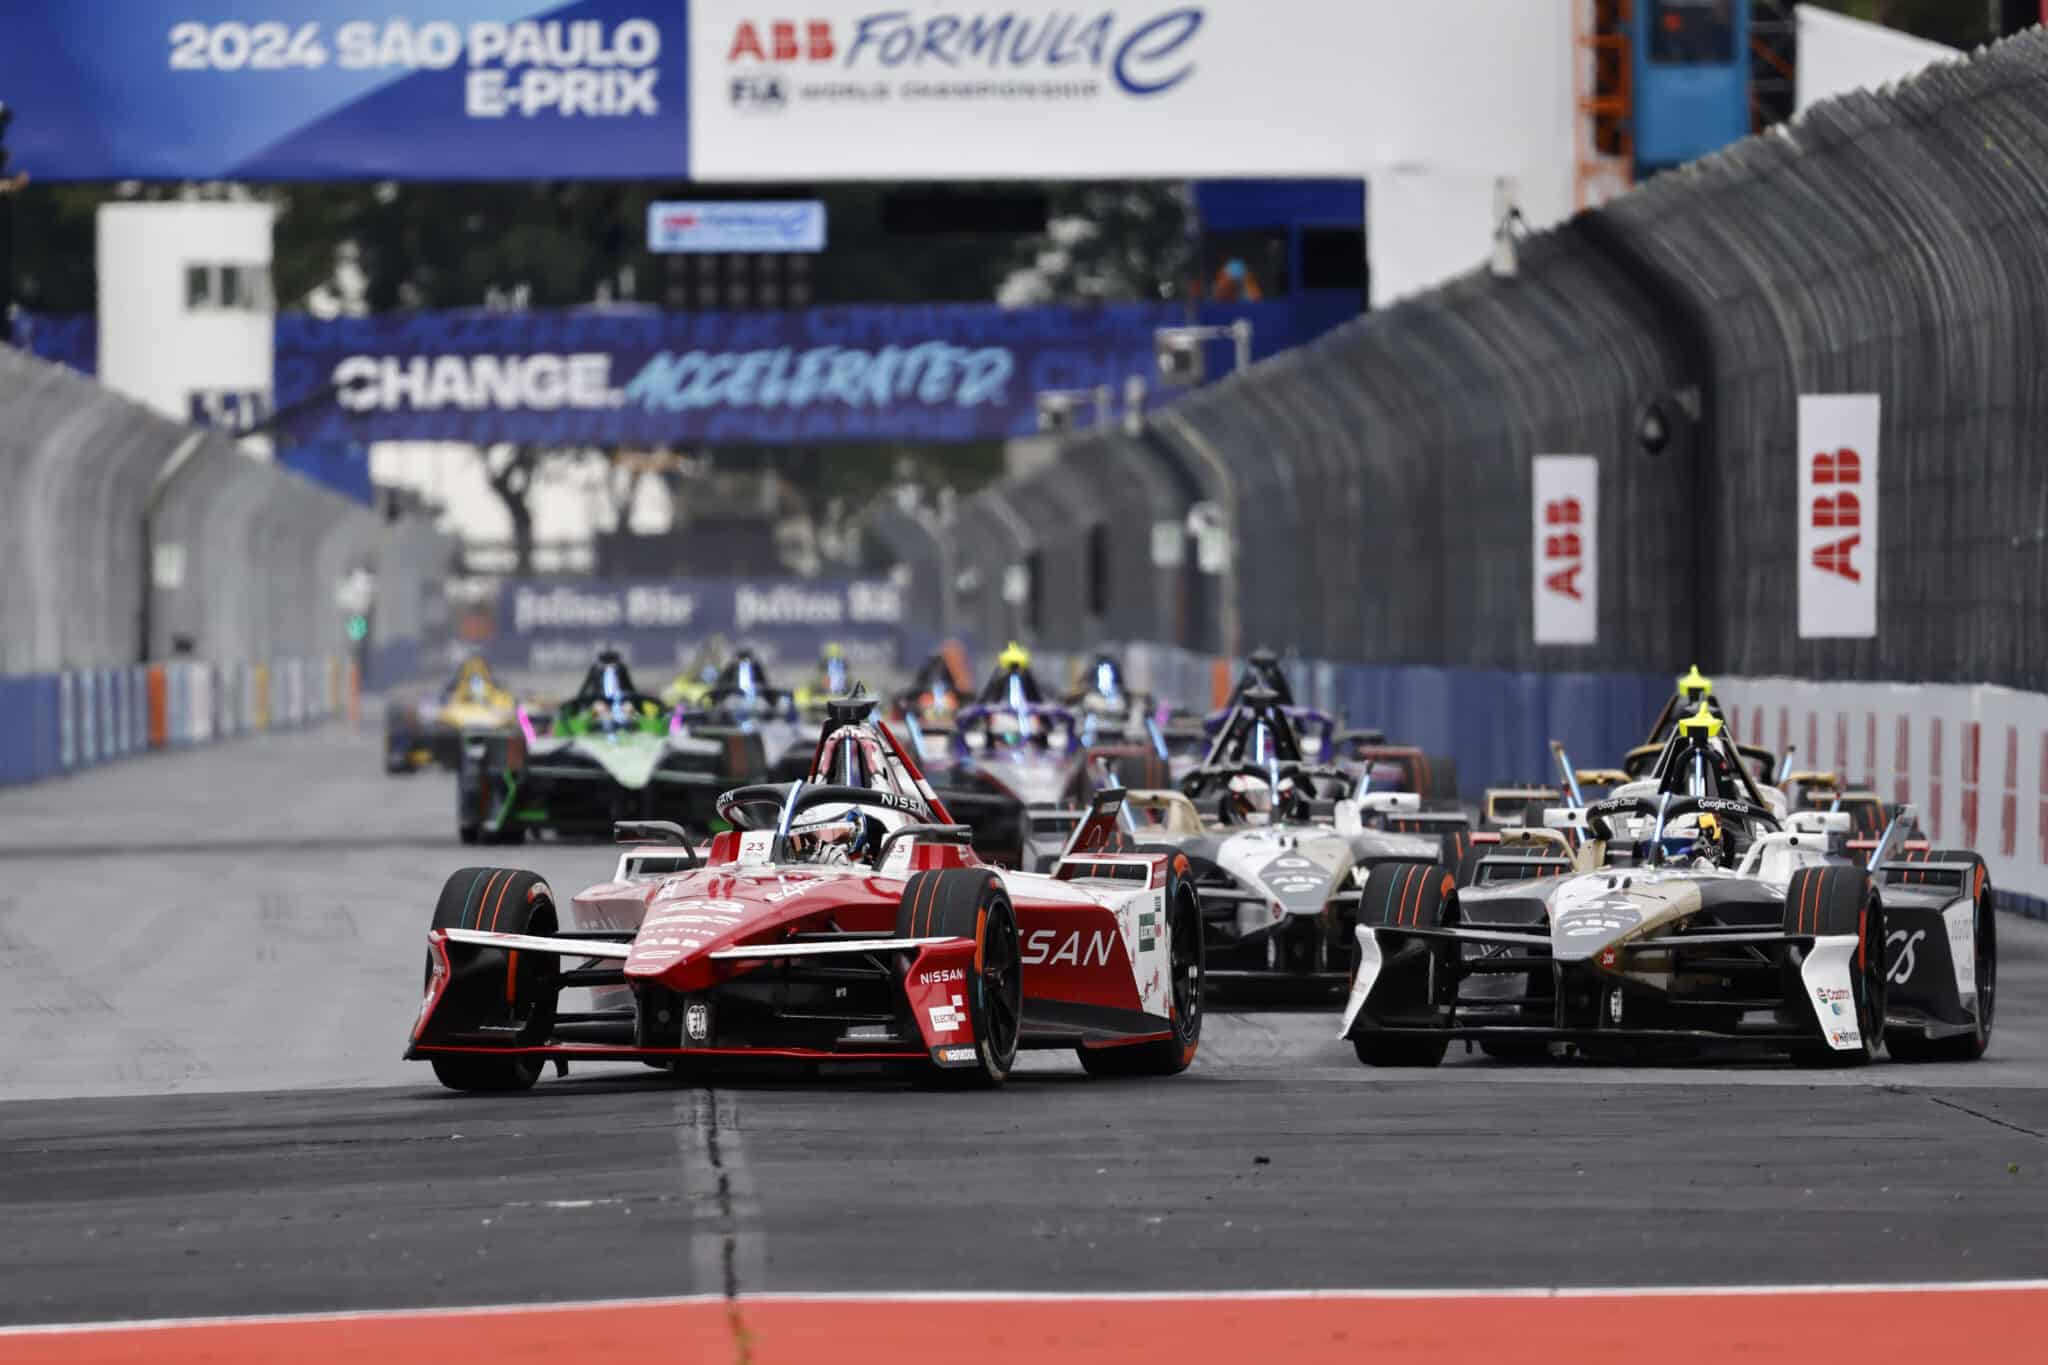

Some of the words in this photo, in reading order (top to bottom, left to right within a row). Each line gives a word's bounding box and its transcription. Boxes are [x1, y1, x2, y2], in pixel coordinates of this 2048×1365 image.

[168, 21, 328, 70] 2024
[466, 19, 661, 68] PAULO
[727, 20, 835, 61] ABB
[844, 10, 1113, 68] FORMULA
[464, 69, 658, 117] E-PRIX
[730, 77, 787, 109] FIA
[800, 82, 889, 101] WORLD
[901, 80, 1098, 101] CHAMPIONSHIP
[1811, 446, 1862, 583] ABB
[1544, 496, 1584, 600] ABB
[1697, 799, 1726, 812] Google
[1727, 800, 1749, 813] Cloud
[744, 842, 765, 852] 23
[1018, 929, 1117, 966] SAN
[920, 968, 966, 985] NISSAN
